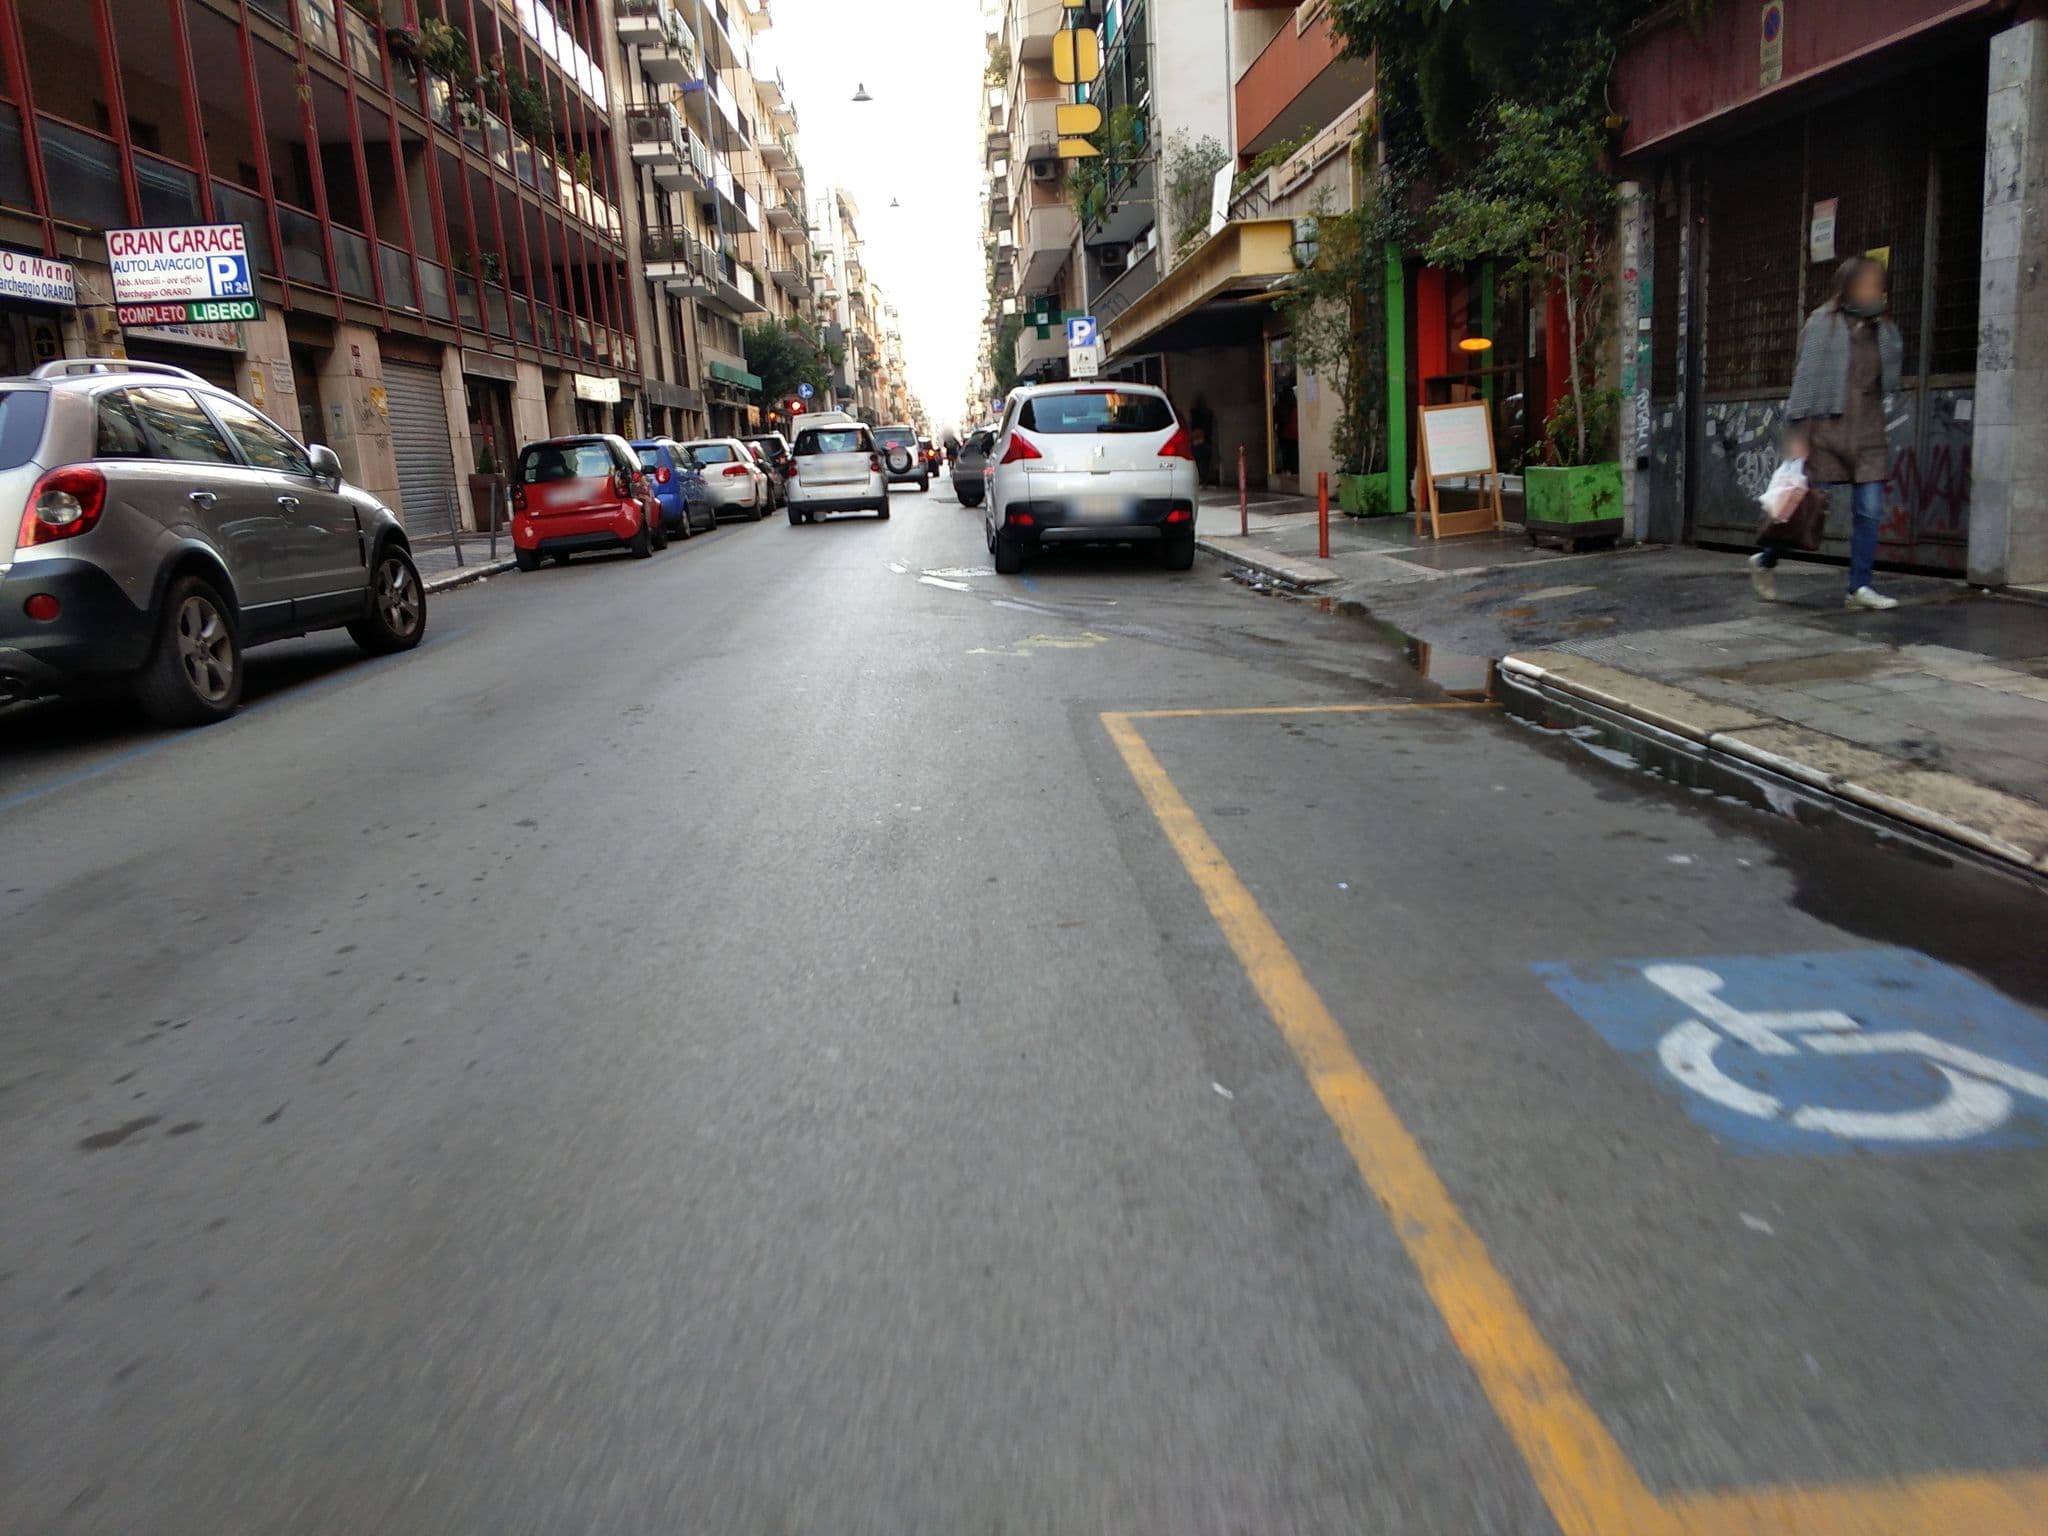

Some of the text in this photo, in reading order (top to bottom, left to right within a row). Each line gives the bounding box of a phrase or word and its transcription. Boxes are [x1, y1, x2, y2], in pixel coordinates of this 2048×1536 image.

[110, 228, 244, 256] GRAN GARAGE
[32, 259, 71, 283] Mano
[113, 257, 205, 273] AUTOLAVAGGIO
[180, 275, 203, 286] ufficio
[209, 256, 238, 296] P
[41, 282, 74, 301] ORARIO
[118, 287, 192, 299] Parcheggio ORARIO
[224, 280, 249, 294] H 24
[118, 306, 186, 323] COMPLETO
[192, 302, 254, 321] LIBERO
[1073, 320, 1092, 346] P
